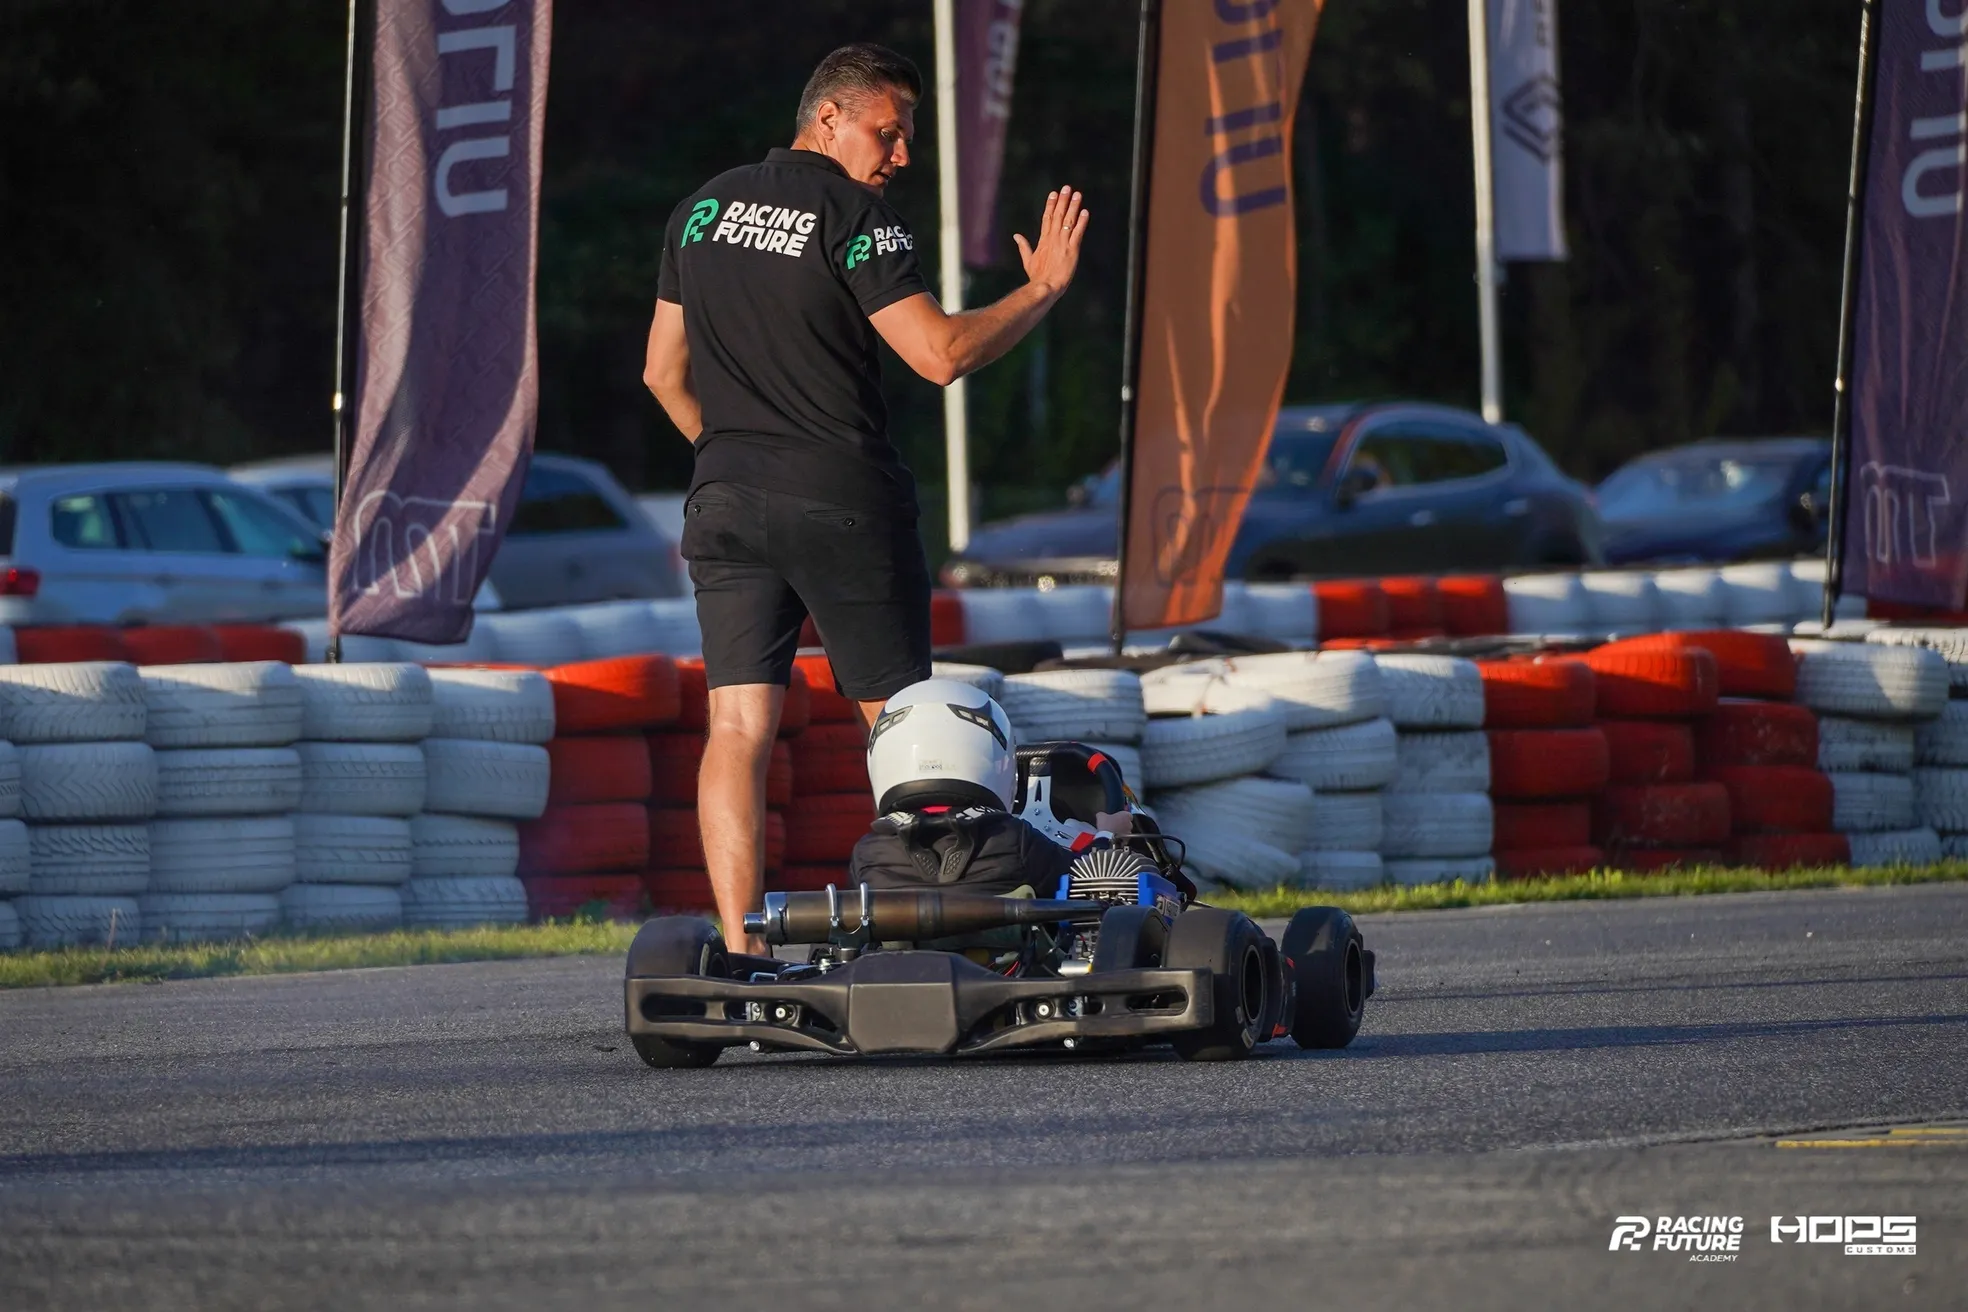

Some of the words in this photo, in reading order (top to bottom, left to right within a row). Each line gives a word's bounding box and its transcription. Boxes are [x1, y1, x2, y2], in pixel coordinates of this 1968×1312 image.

[722, 201, 817, 235] RACING
[873, 225, 908, 242] RAC
[712, 220, 809, 258] FUTURE
